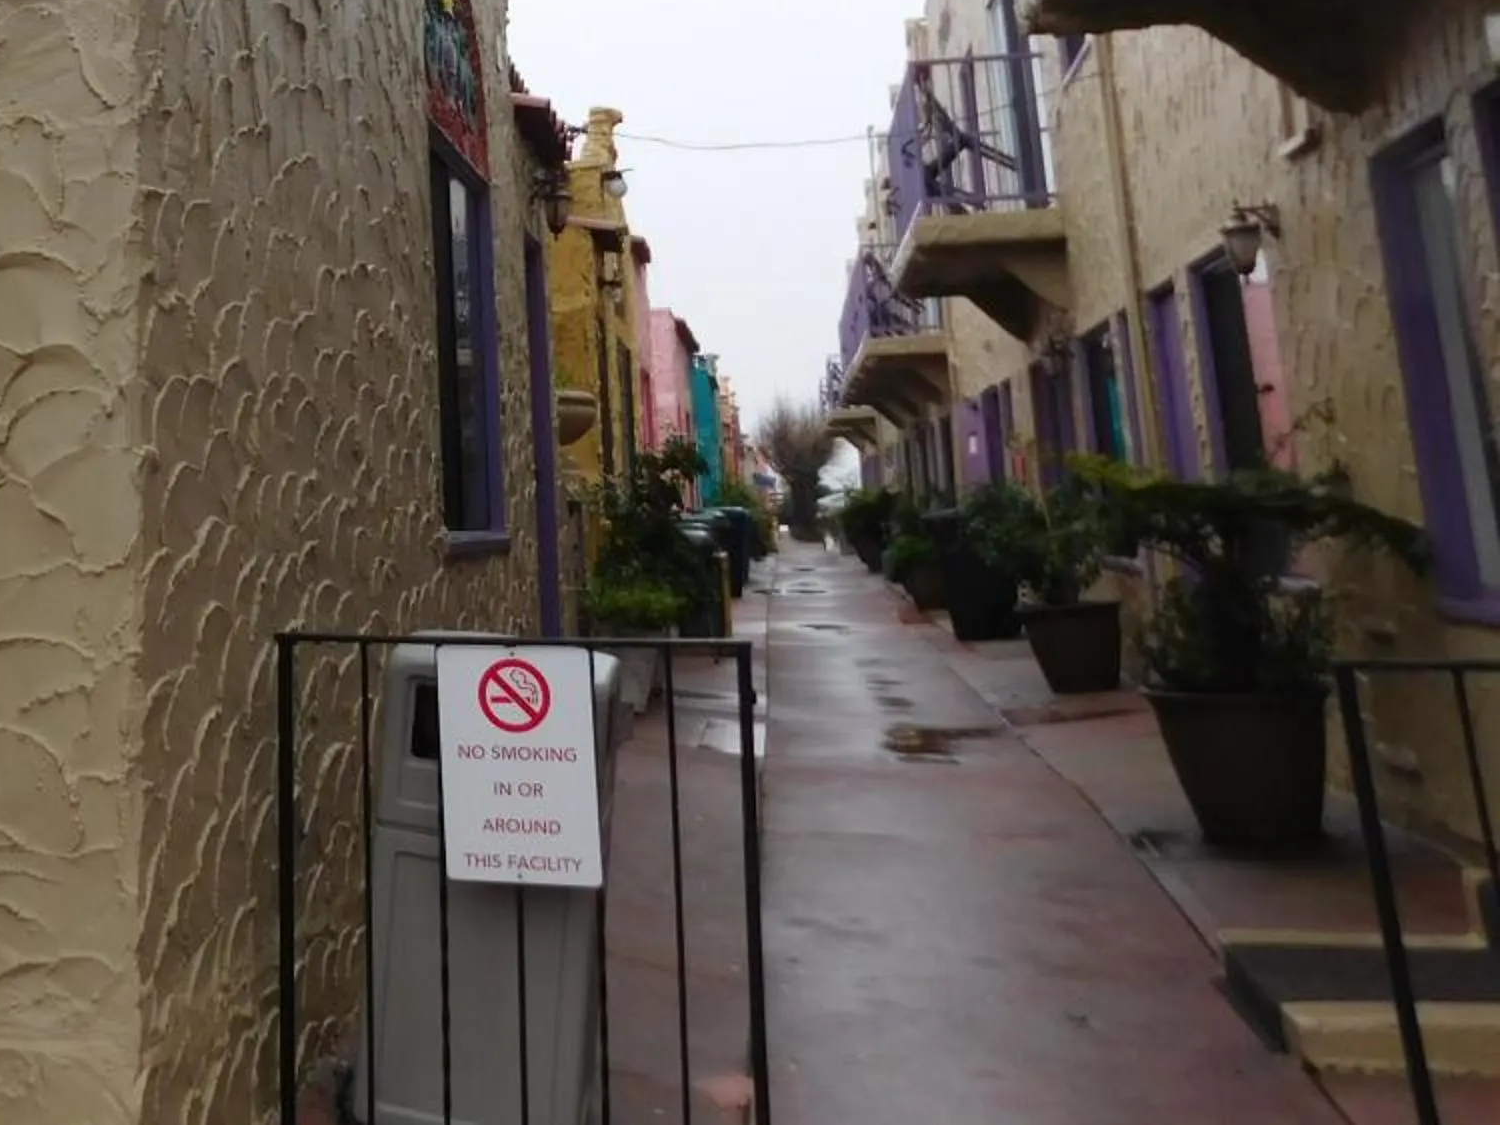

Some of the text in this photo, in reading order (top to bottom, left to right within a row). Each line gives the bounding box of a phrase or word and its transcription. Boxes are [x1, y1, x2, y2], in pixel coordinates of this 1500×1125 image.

[457, 744, 577, 763] NO SMOKING
[493, 782, 544, 798] IN OR
[483, 818, 561, 836] AROUND
[465, 853, 583, 873] THIS FACILITY
